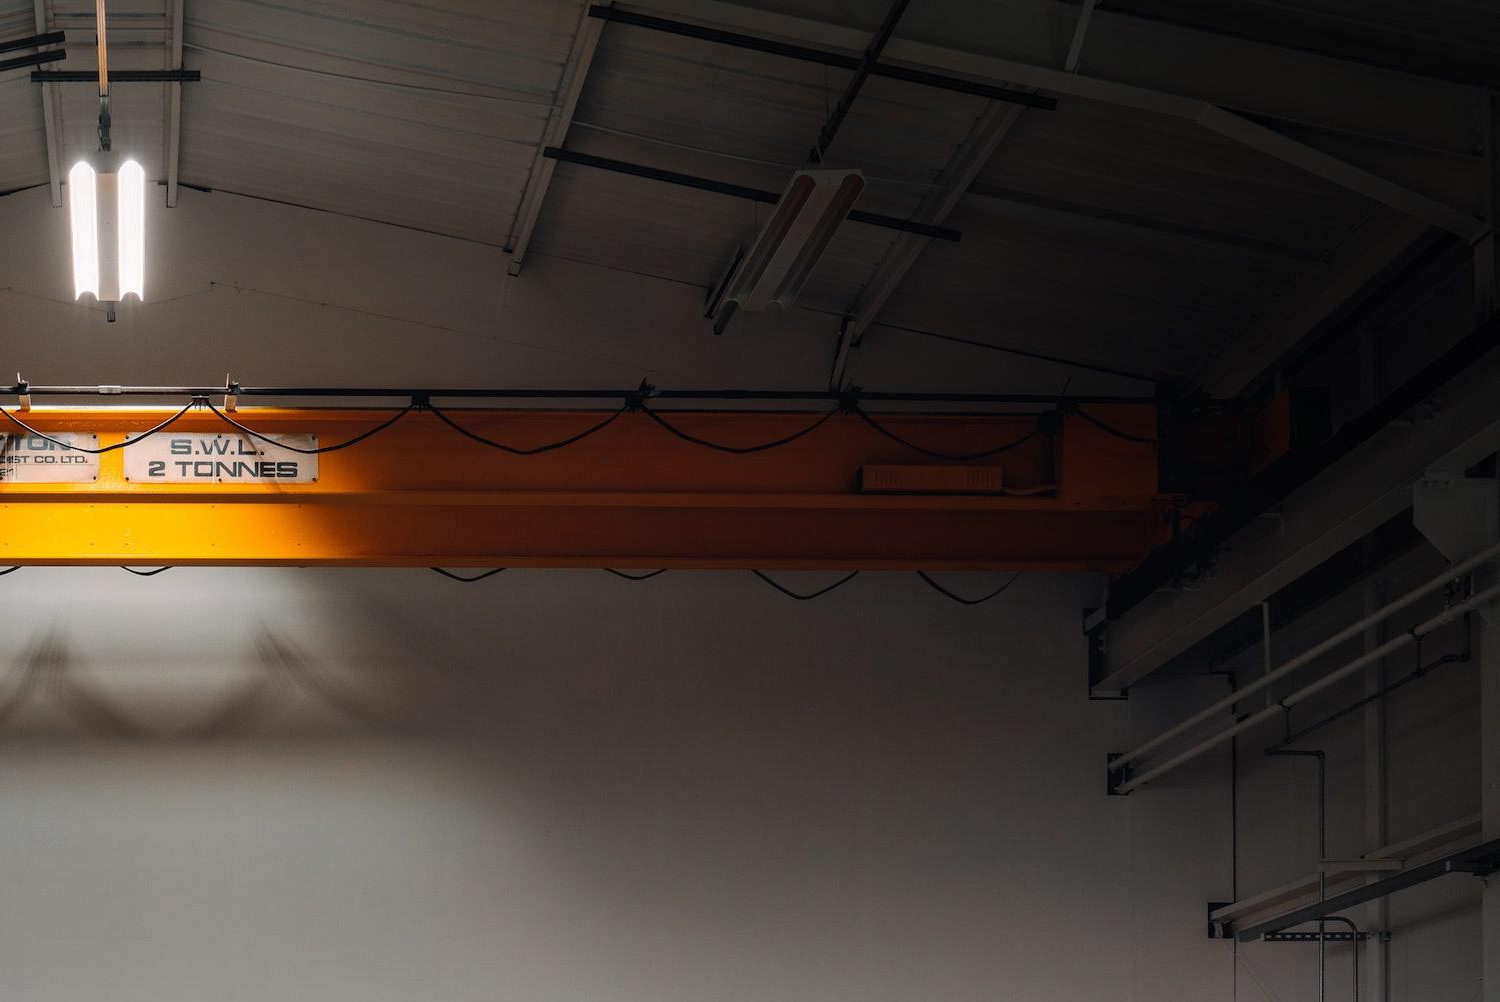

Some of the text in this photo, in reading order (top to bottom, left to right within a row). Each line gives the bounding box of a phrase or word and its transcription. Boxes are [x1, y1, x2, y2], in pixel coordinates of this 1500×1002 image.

[171, 439, 265, 456] S.W.L.
[148, 461, 298, 477] 2 TONNES
